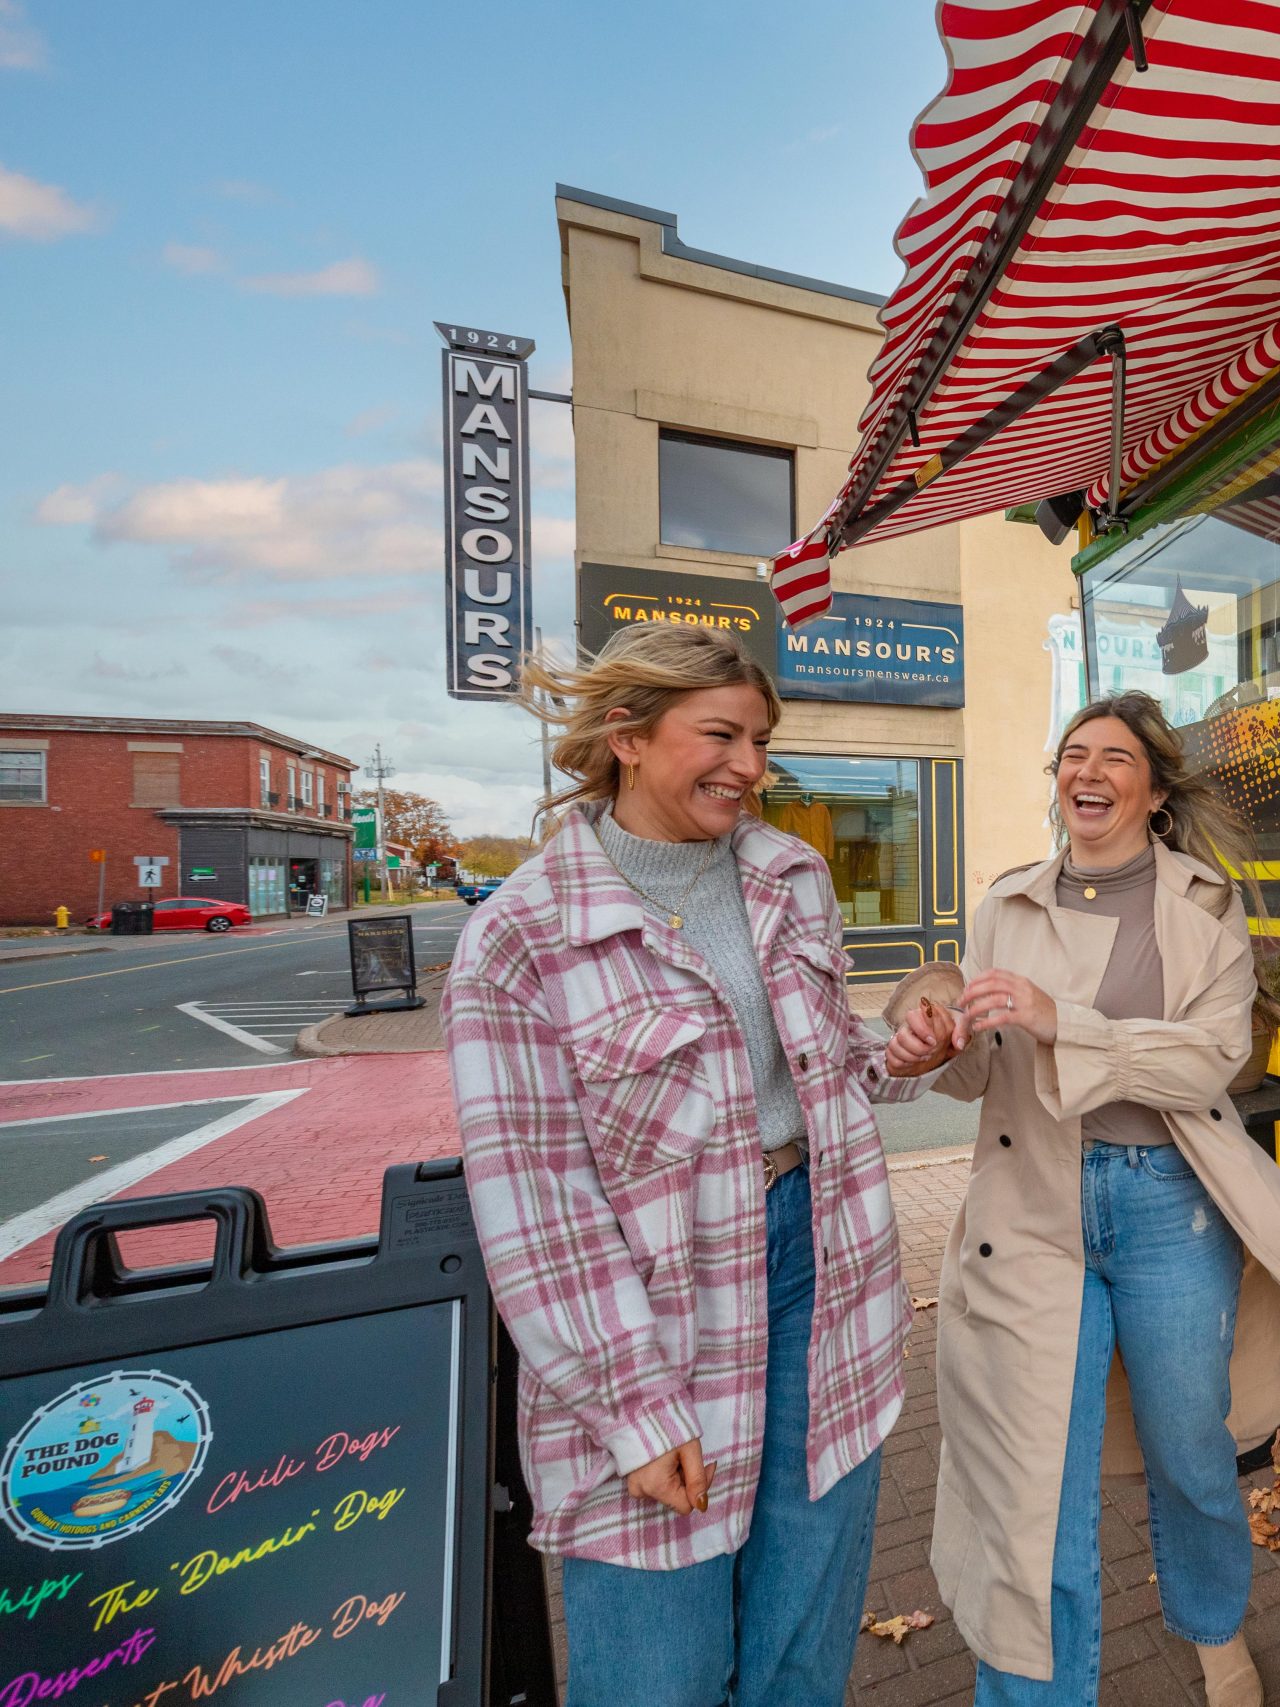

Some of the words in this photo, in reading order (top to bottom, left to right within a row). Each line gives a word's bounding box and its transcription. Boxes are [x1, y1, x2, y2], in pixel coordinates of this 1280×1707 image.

[449, 328, 518, 351] 1924
[454, 357, 516, 688] MANSOURS
[667, 596, 701, 606] 1924
[613, 606, 752, 632] MANSOUR'S
[854, 617, 895, 630] 1924
[787, 635, 956, 664] MANSOUR'S
[795, 664, 950, 683] mansoursmenswear.ca
[25, 1442, 70, 1461] THE
[74, 1433, 119, 1452] DOG
[21, 1452, 100, 1478] POUND
[207, 1454, 305, 1514] Chili
[315, 1425, 401, 1472] Dogs
[30, 1507, 60, 1530] GOURMET
[60, 1524, 97, 1535] HOTDOGS
[100, 1519, 117, 1530] AND
[118, 1497, 157, 1523] CARNIVAL
[154, 1480, 172, 1497] EATS
[88, 1580, 160, 1632] The
[333, 1488, 406, 1532] Dog
[0, 1572, 85, 1621] hips
[182, 1621, 322, 1700] Whistle
[332, 1591, 407, 1639] Dog
[0, 1628, 157, 1707] Desserts
